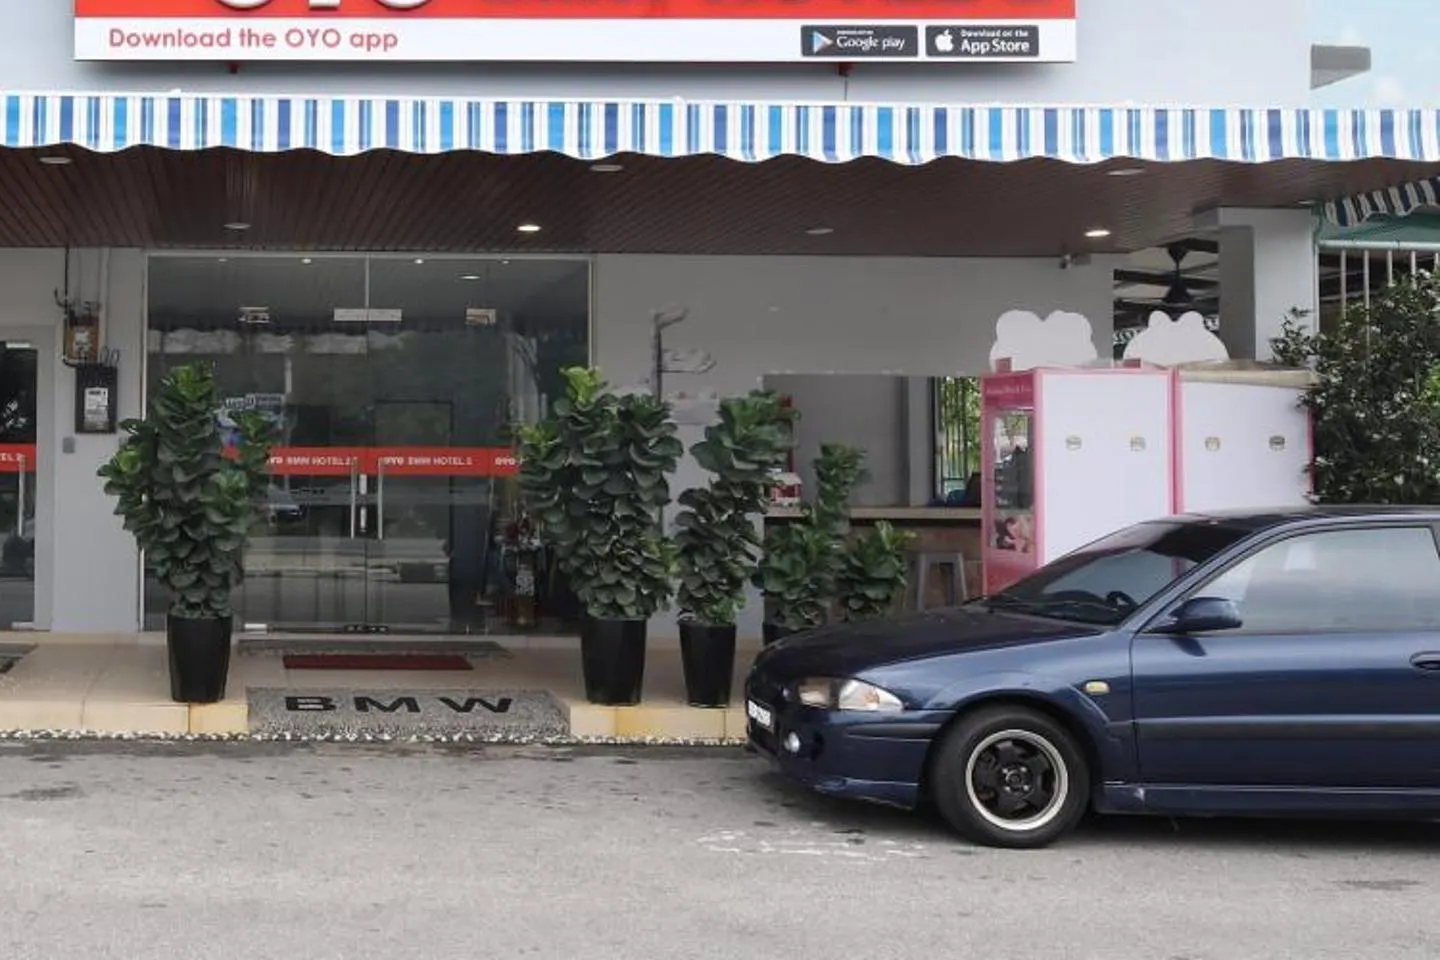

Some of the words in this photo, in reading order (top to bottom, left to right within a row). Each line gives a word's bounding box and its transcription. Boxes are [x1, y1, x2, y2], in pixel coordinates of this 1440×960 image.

[109, 27, 232, 48] Download
[238, 27, 277, 48] the
[284, 27, 341, 49] OYO
[349, 33, 398, 52] app
[836, 35, 879, 51] Google
[882, 37, 905, 51] play
[961, 39, 990, 54] App
[991, 38, 1030, 52] Store
[285, 696, 513, 713] BMW
